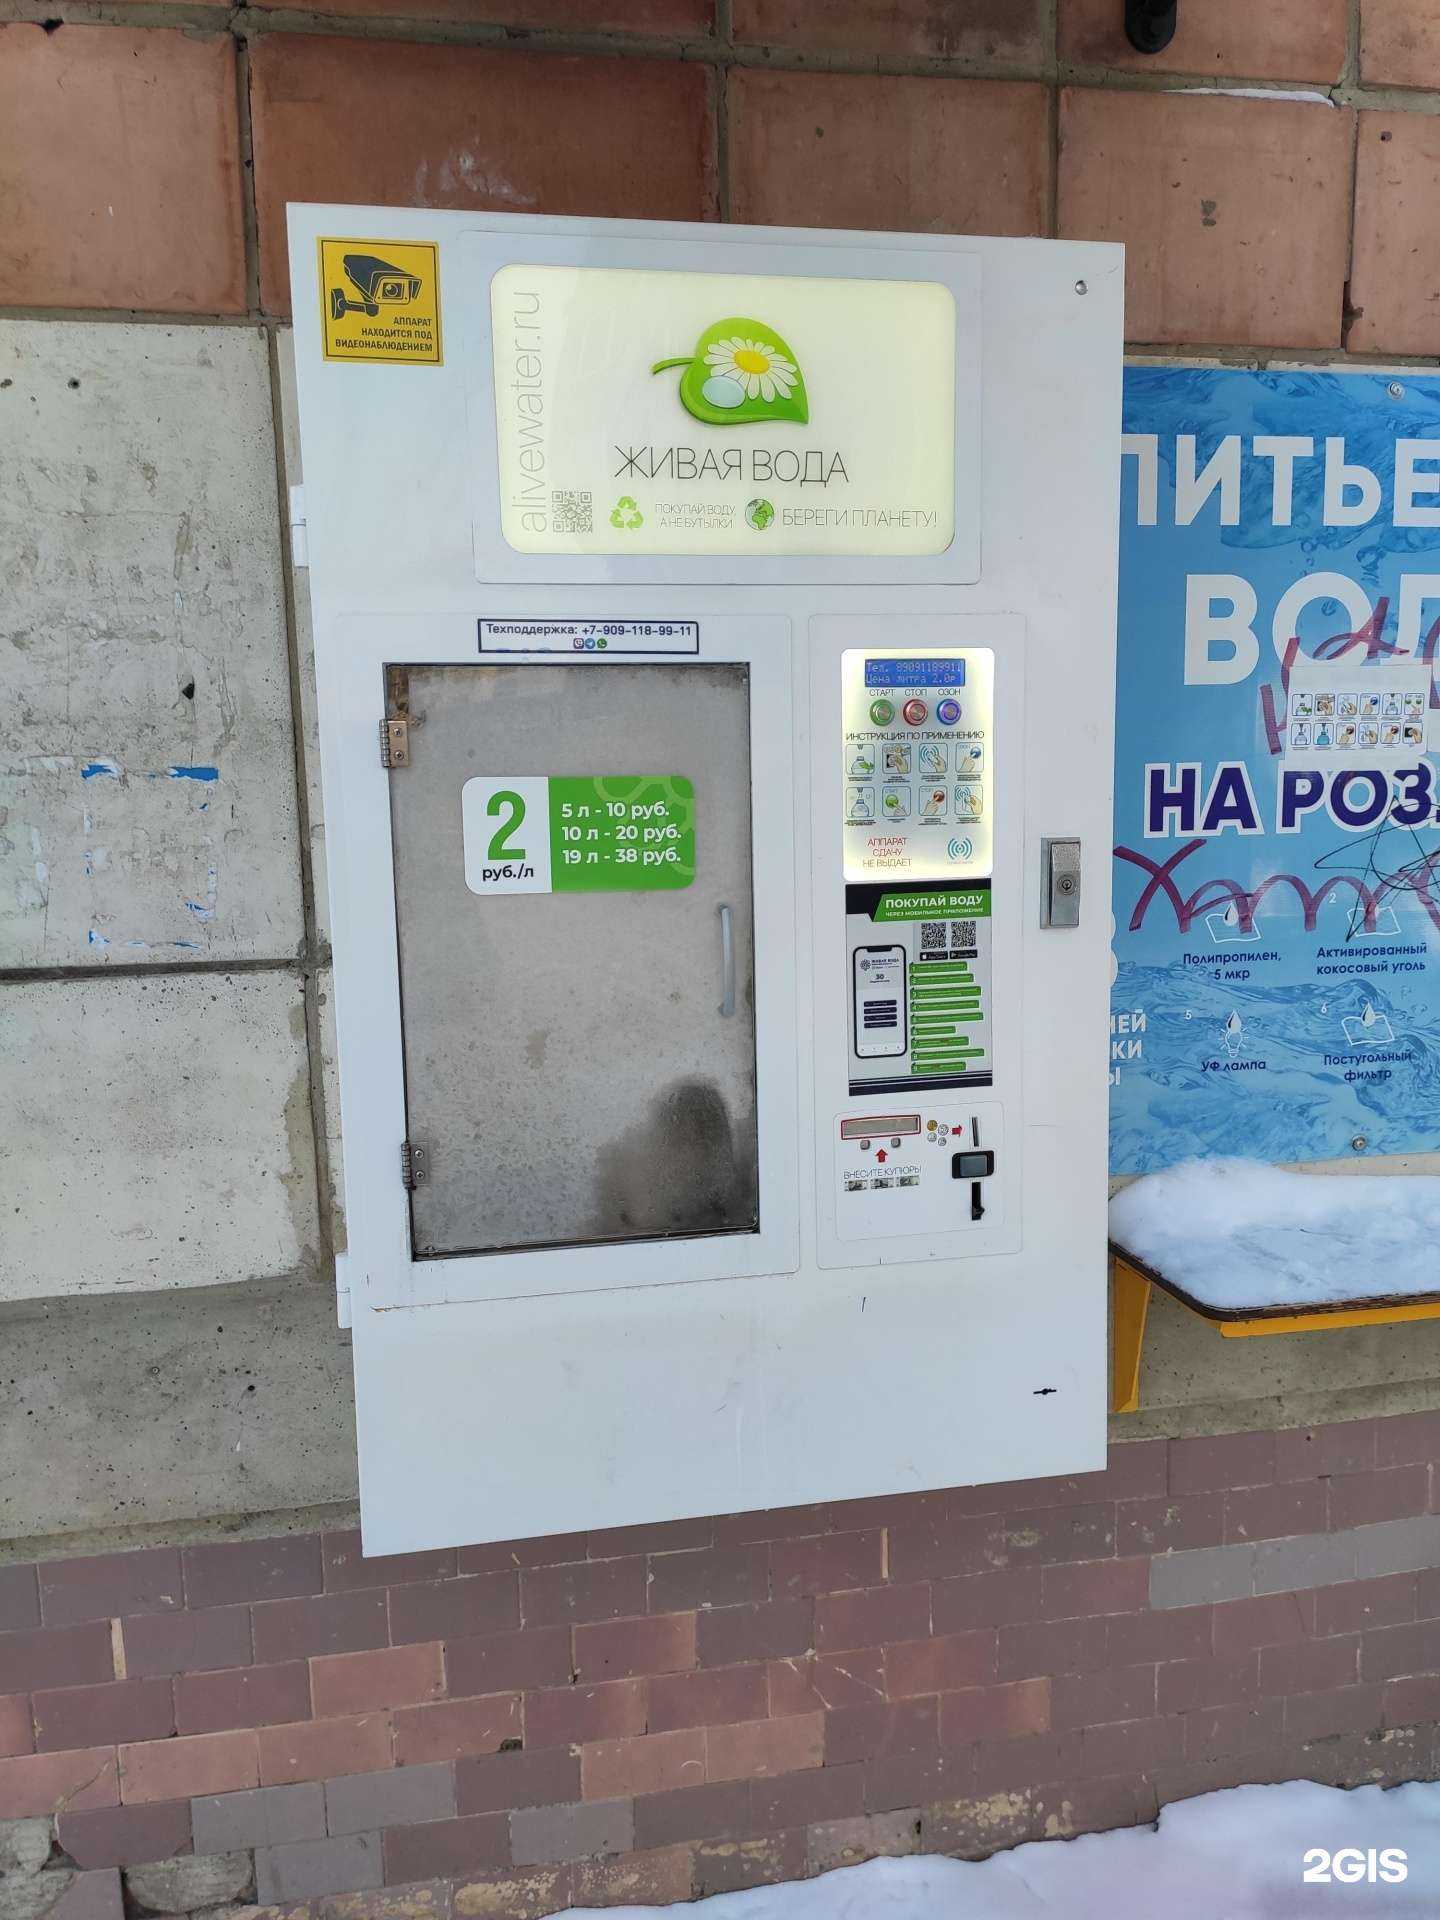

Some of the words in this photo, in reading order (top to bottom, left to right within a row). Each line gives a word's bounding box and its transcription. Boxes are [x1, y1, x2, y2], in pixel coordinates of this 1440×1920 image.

[393, 317, 432, 327] АППАРАТ
[361, 328, 412, 339] НАХОДИТСЯ
[415, 330, 432, 340] ПОД
[335, 338, 432, 352] ВИДЕОНАБЛЮДЕНИЕМ
[511, 292, 547, 533] alivewater.ru
[614, 446, 743, 480] ЖИВАЯ
[752, 449, 849, 488] ВОДА
[655, 502, 705, 514] ПОКУПАЙ
[707, 504, 736, 515] ВОДУ
[668, 518, 682, 528] НЕ
[684, 518, 733, 529] БУТЫЛКИ
[782, 508, 848, 527] БЕРЕГИ
[852, 509, 938, 528] ПЛАНЕТУ!
[486, 623, 578, 636] Техподдержка:
[582, 625, 691, 637] +7-909-118-99-11
[869, 689, 896, 697] СТАРТ
[904, 688, 928, 697] СТОП
[938, 688, 961, 696] ОЗОН
[846, 731, 905, 741] ИНСТРУКЦИЯ
[906, 731, 920, 741] ПО
[921, 730, 985, 740] ПРИМЕНЕНИЮ
[1146, 763, 1261, 835] НА
[1278, 762, 1440, 832] РОЗ
[561, 803, 572, 818] 5
[577, 805, 590, 817] л
[606, 802, 626, 817] 10
[631, 801, 669, 820] руб.
[486, 790, 526, 861] 2
[562, 826, 582, 840] 10
[586, 828, 598, 840] л
[615, 825, 638, 840] 20
[643, 824, 682, 843] руб.
[868, 837, 907, 846] АППАРАТ
[562, 849, 581, 864] 19
[586, 851, 598, 864] л
[615, 849, 637, 864] 38
[643, 847, 681, 866] руб.
[872, 848, 902, 857] СДАЧУ
[863, 859, 875, 867] НЕ
[876, 858, 912, 868] ВЫДАЕТ
[482, 864, 535, 881] руб./л
[885, 895, 946, 908] ПОКУПАЙ
[949, 895, 984, 906] ВОДУ
[1328, 893, 1337, 904] 2
[943, 907, 984, 915] ПРИЛОЖЕНИЕ
[1316, 942, 1427, 959] Активированный
[1183, 951, 1282, 967] Полипропилен,
[1316, 960, 1389, 975] кокосовый
[1392, 961, 1426, 974] уголь
[1213, 969, 1222, 980] 5
[1225, 969, 1250, 982] мкр
[1185, 1010, 1192, 1020] 5
[1321, 1003, 1328, 1014] 6
[1324, 1050, 1412, 1067] Постугольный
[1201, 1060, 1220, 1072] УФ
[1223, 1059, 1267, 1072] лампа
[1344, 1068, 1392, 1083] фильтр
[843, 1168, 884, 1180] ВНЕСИТЕ
[884, 1165, 922, 1178] КУПЮРЫ
